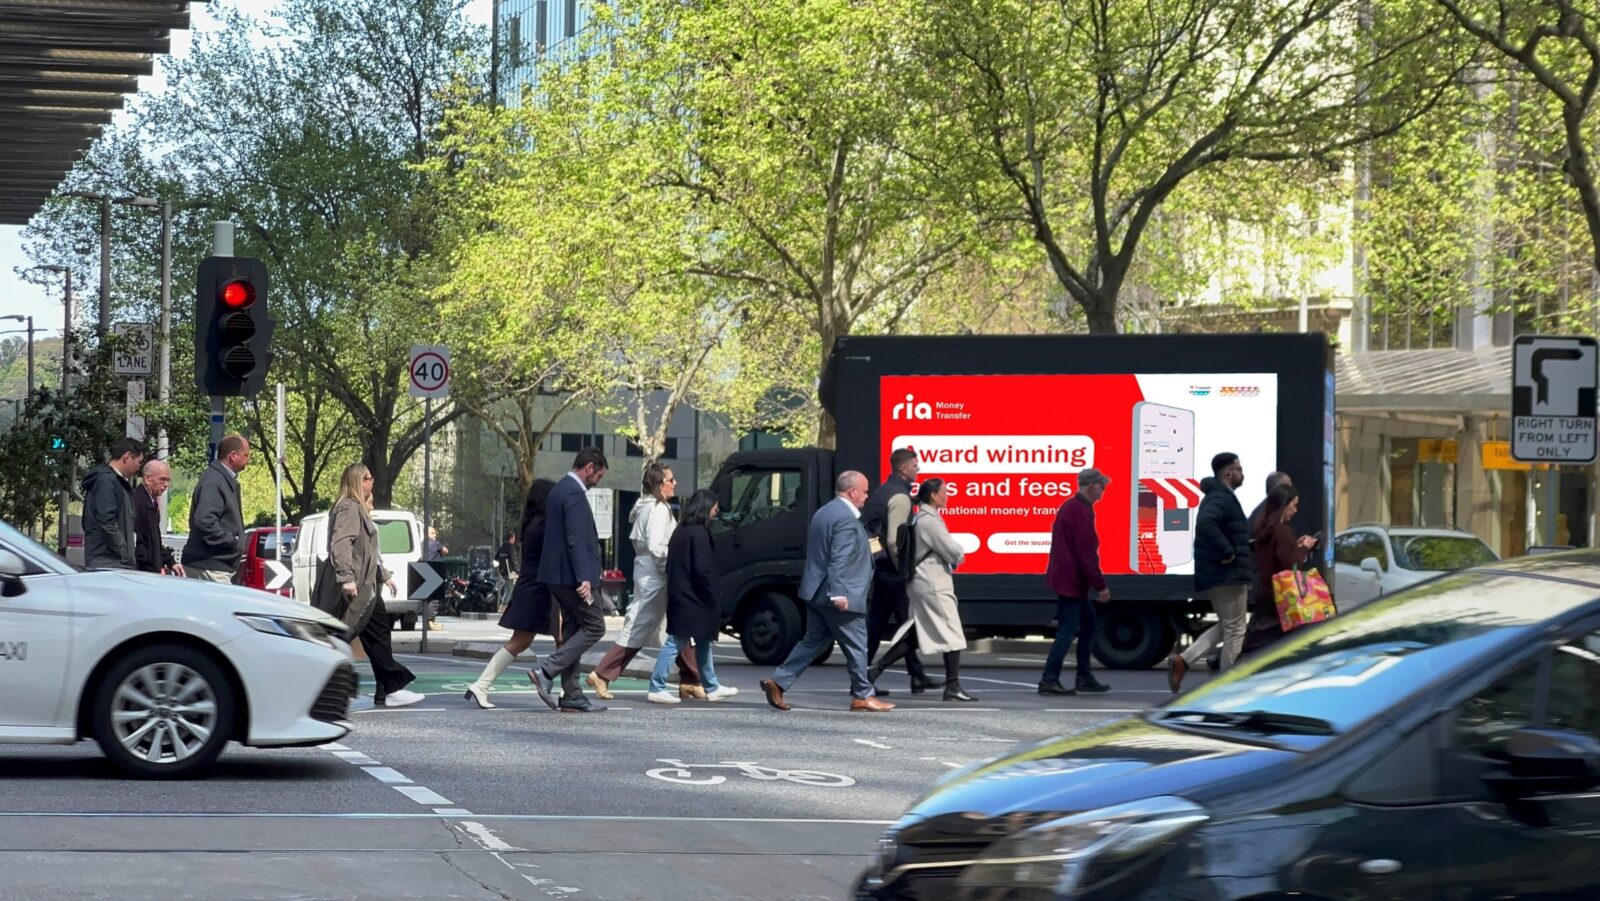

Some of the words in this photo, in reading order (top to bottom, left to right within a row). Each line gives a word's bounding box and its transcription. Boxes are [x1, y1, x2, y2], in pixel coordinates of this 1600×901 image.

[119, 356, 148, 368] LANE
[414, 362, 444, 381] 40
[892, 393, 932, 420] ria
[936, 402, 964, 410] Money
[1518, 418, 1556, 429] RIGHT
[1559, 419, 1592, 430] TURN
[1519, 432, 1554, 443] FROM
[1559, 433, 1590, 443] LEFT
[907, 445, 978, 463] ward
[987, 445, 1087, 467] winning
[1536, 447, 1572, 457] ONLY
[965, 478, 1010, 497] and
[1018, 478, 1072, 497] fees
[990, 508, 1030, 517] money
